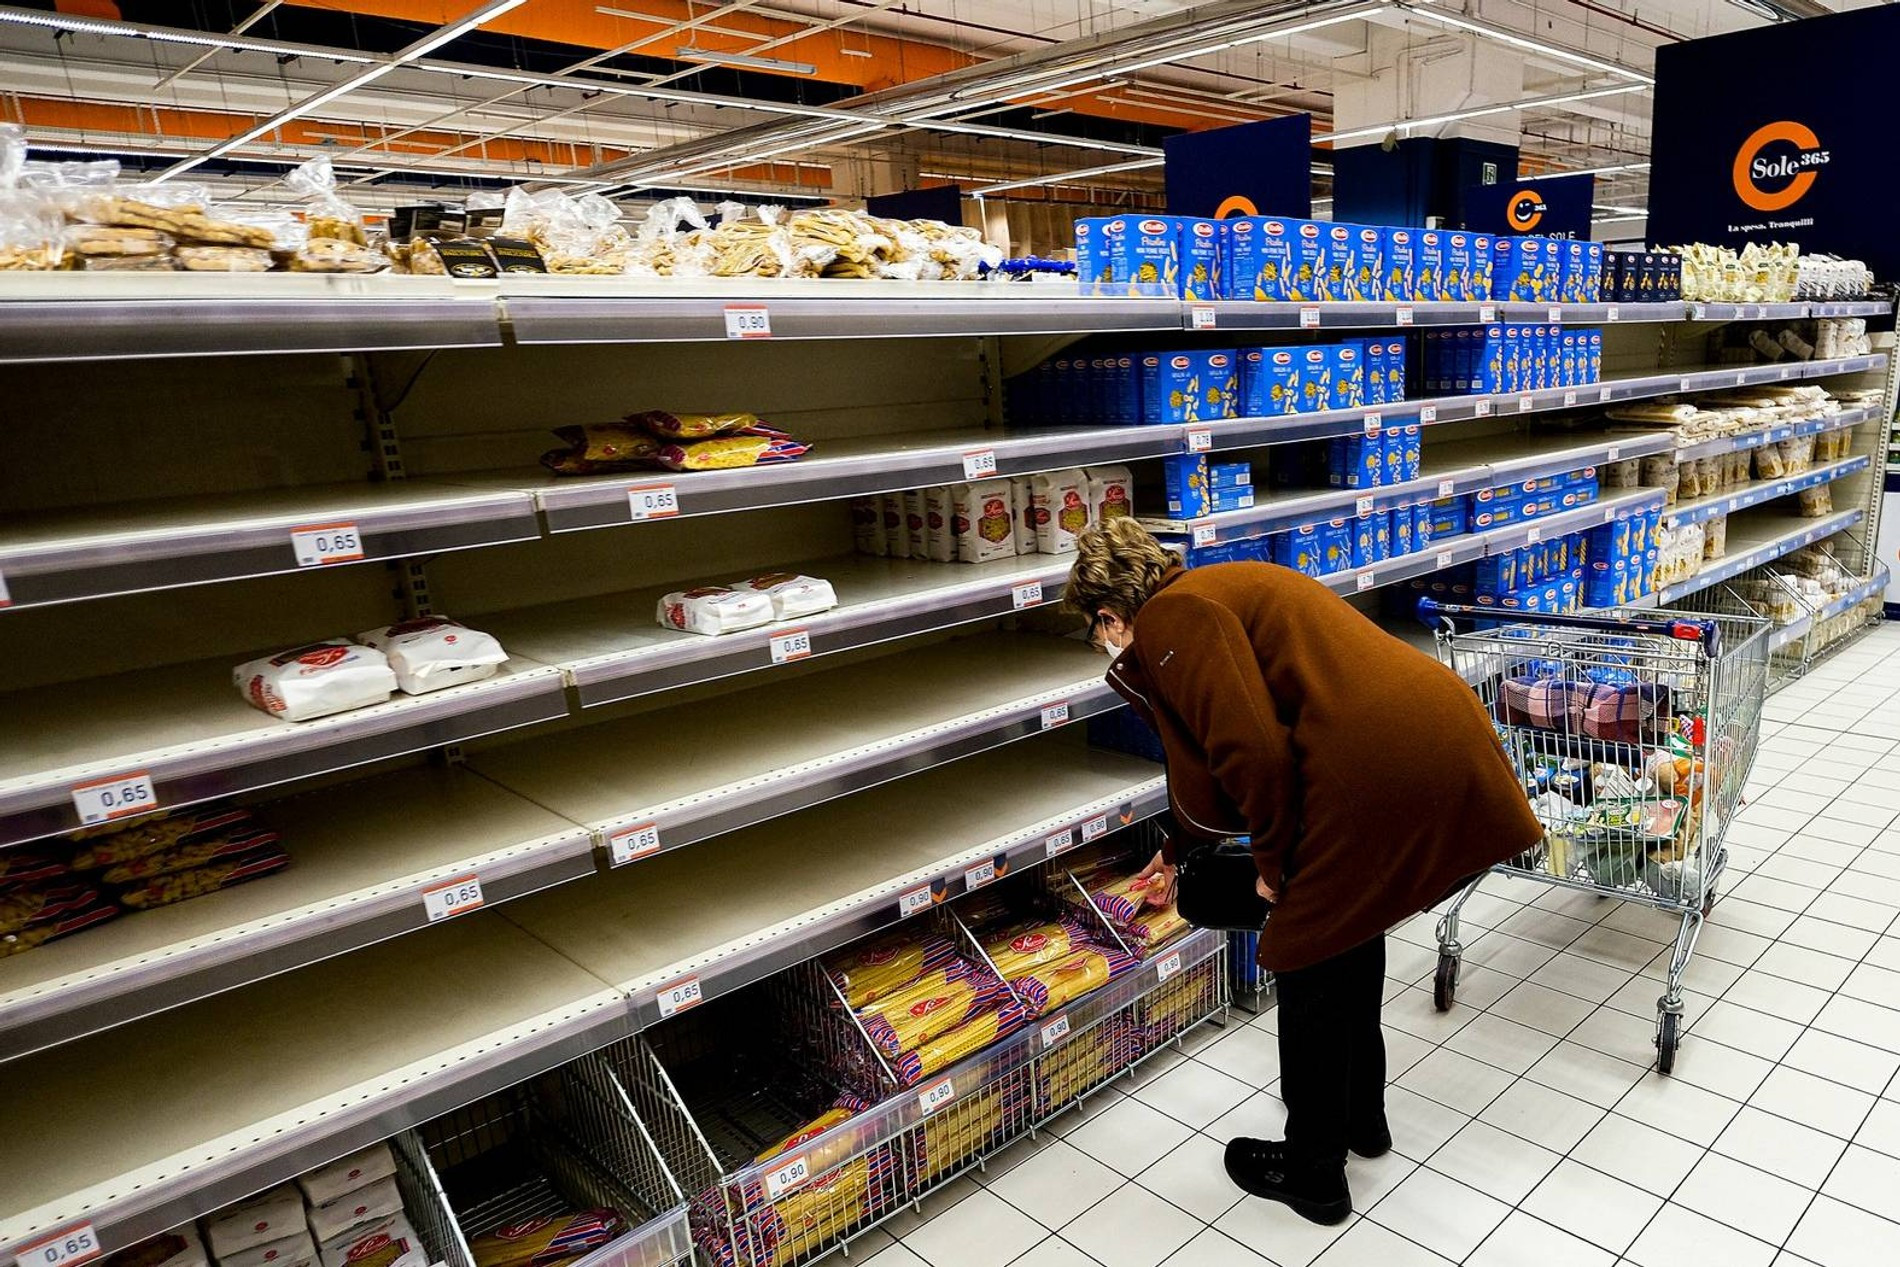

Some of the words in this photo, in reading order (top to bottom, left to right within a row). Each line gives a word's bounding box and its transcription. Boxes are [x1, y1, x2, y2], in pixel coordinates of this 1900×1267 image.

[1752, 156, 1799, 178] Sole
[1800, 152, 1830, 165] 365
[738, 316, 764, 329] 0,90
[645, 493, 673, 510] 0,65
[317, 534, 356, 553] 0,65
[1023, 587, 1040, 600] 0,65
[784, 637, 807, 652] 0,65
[1050, 707, 1066, 719] 0,65
[101, 785, 147, 807] 0,65
[1090, 820, 1105, 833] 0,90
[628, 833, 655, 850] 0,65
[975, 866, 992, 880] 0,90
[445, 885, 478, 906] 0,65
[910, 891, 929, 906] 0,90
[673, 984, 698, 1003] 0,65
[1050, 1021, 1067, 1037] 0,90
[930, 1084, 950, 1103] 0,90
[780, 1164, 804, 1184] 0,90
[44, 1234, 92, 1263] 0,65
